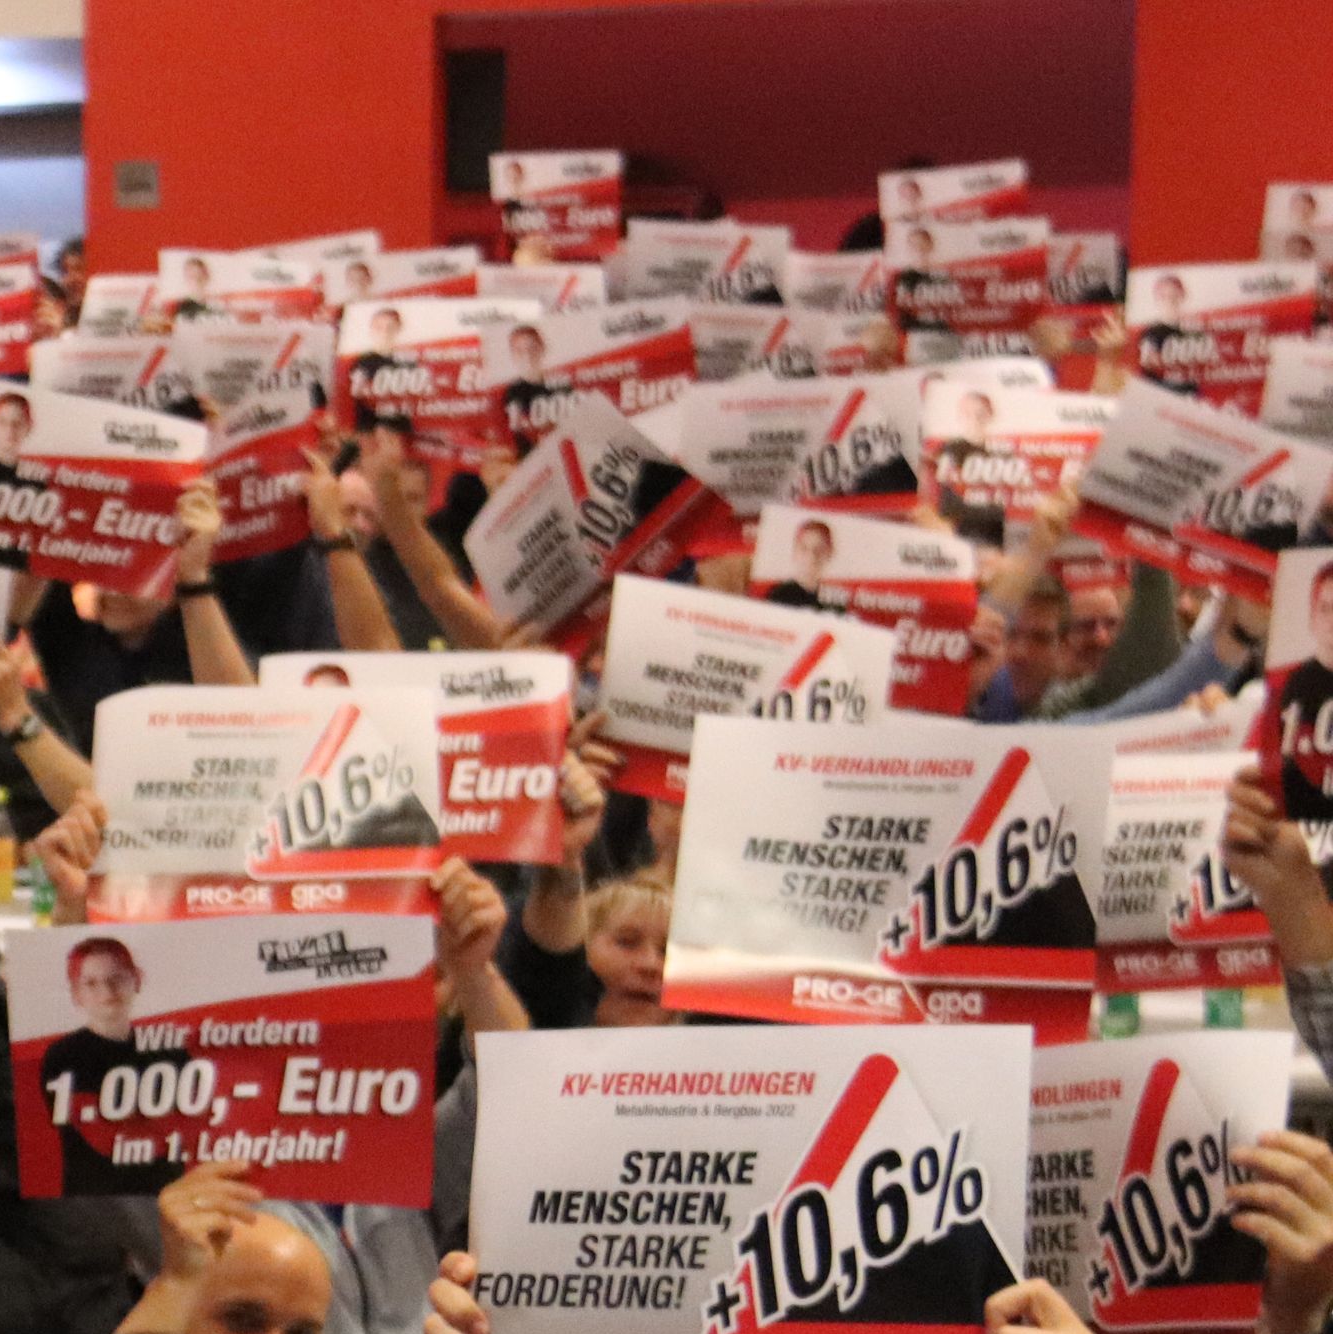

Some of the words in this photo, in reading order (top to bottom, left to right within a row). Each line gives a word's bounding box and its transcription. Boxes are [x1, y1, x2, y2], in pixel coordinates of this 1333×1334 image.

[94, 498, 180, 545] Euro
[447, 761, 554, 801] Euro
[774, 753, 974, 779] KV-VERHANDLUNGEN
[253, 744, 414, 855] +10,6%
[823, 815, 931, 844] STARKE
[743, 838, 909, 875] MENSCHEN,
[778, 873, 891, 905] STARKE
[882, 806, 1078, 951] +10,6%
[927, 989, 984, 1023] gpa
[134, 1022, 188, 1053] Wir
[198, 1019, 321, 1047] fordern
[45, 1058, 260, 1127] 1.000,-
[279, 1057, 420, 1117] Euro
[560, 1072, 817, 1097] KV-VERHANDLUNGEN
[713, 1104, 762, 1118] Bergbau
[765, 1104, 795, 1117] 2022
[111, 1134, 153, 1165] im
[164, 1132, 191, 1162] 1.
[196, 1129, 347, 1163] Lehrjahr!
[619, 1150, 759, 1186] STARKE
[529, 1192, 733, 1232] MENSCHEN,
[575, 1235, 710, 1270] STARKE
[475, 1274, 685, 1310] FORDERUNG!
